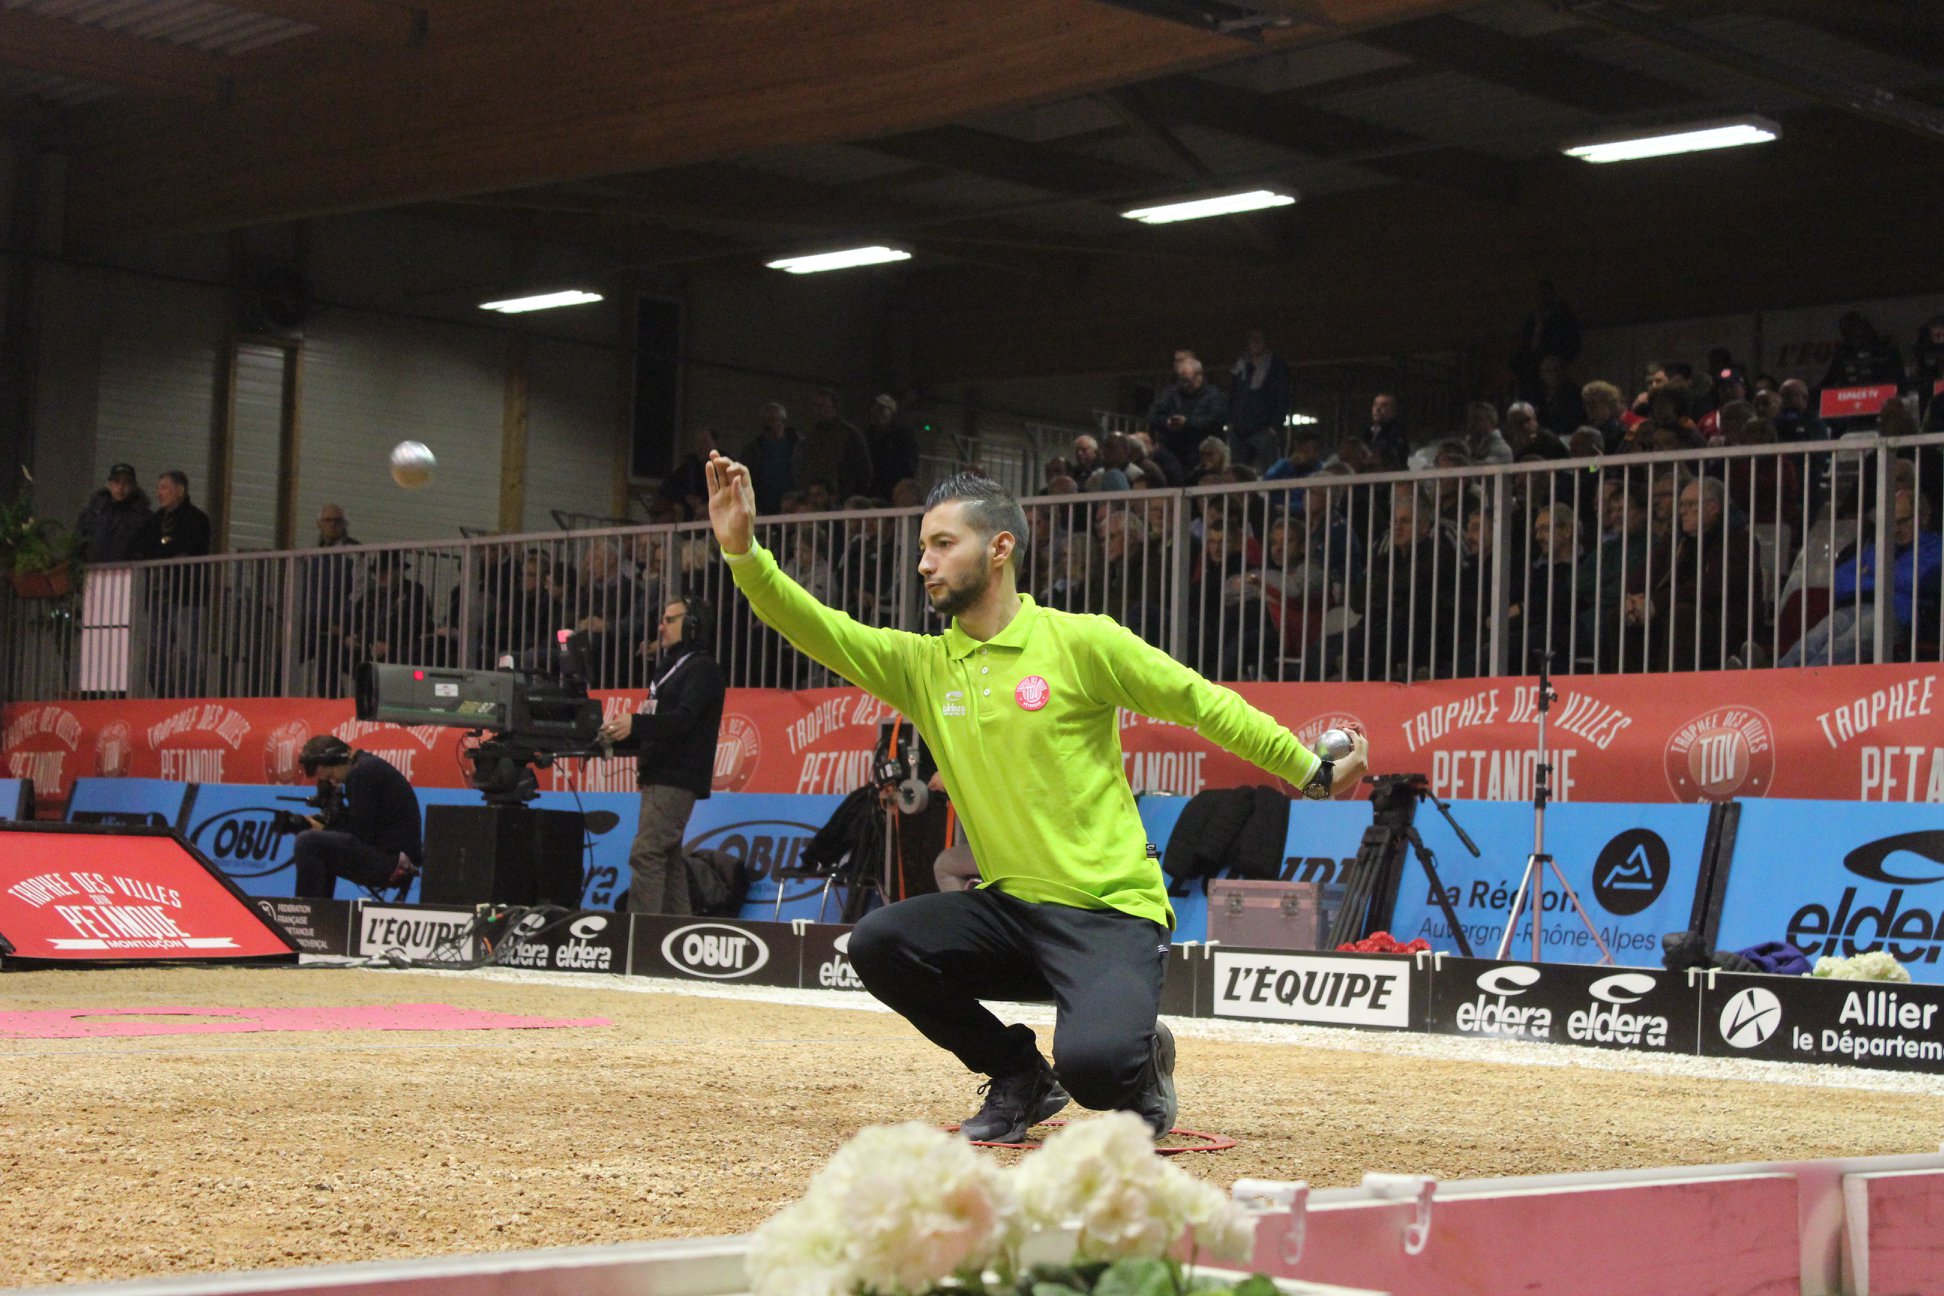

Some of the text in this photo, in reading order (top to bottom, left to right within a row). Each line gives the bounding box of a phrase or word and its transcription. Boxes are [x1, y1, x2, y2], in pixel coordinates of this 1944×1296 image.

[786, 696, 852, 755] TROPHEE
[1402, 689, 1500, 753] TROPHEE
[1554, 691, 1633, 750] VILLES
[1670, 713, 1719, 753] TROPHEE
[1722, 710, 1749, 728] DES
[1816, 675, 1937, 749] TROPHEE
[796, 750, 876, 795] PETANQ
[1699, 731, 1741, 787] TDV
[8, 872, 183, 909] TROPHEE DES VILLES
[1468, 880, 1579, 916] Régon
[54, 905, 192, 941] PETANQUE
[107, 940, 185, 950] MONTLUÇON
[555, 937, 612, 969] eldera
[683, 933, 748, 969] OBUT
[1223, 966, 1398, 1010] L'ÉQUIPE
[1456, 993, 1553, 1038] eldera
[1567, 1002, 1669, 1047] eldera
[1838, 990, 1939, 1030] Allier
[1792, 1026, 1814, 1051] le
